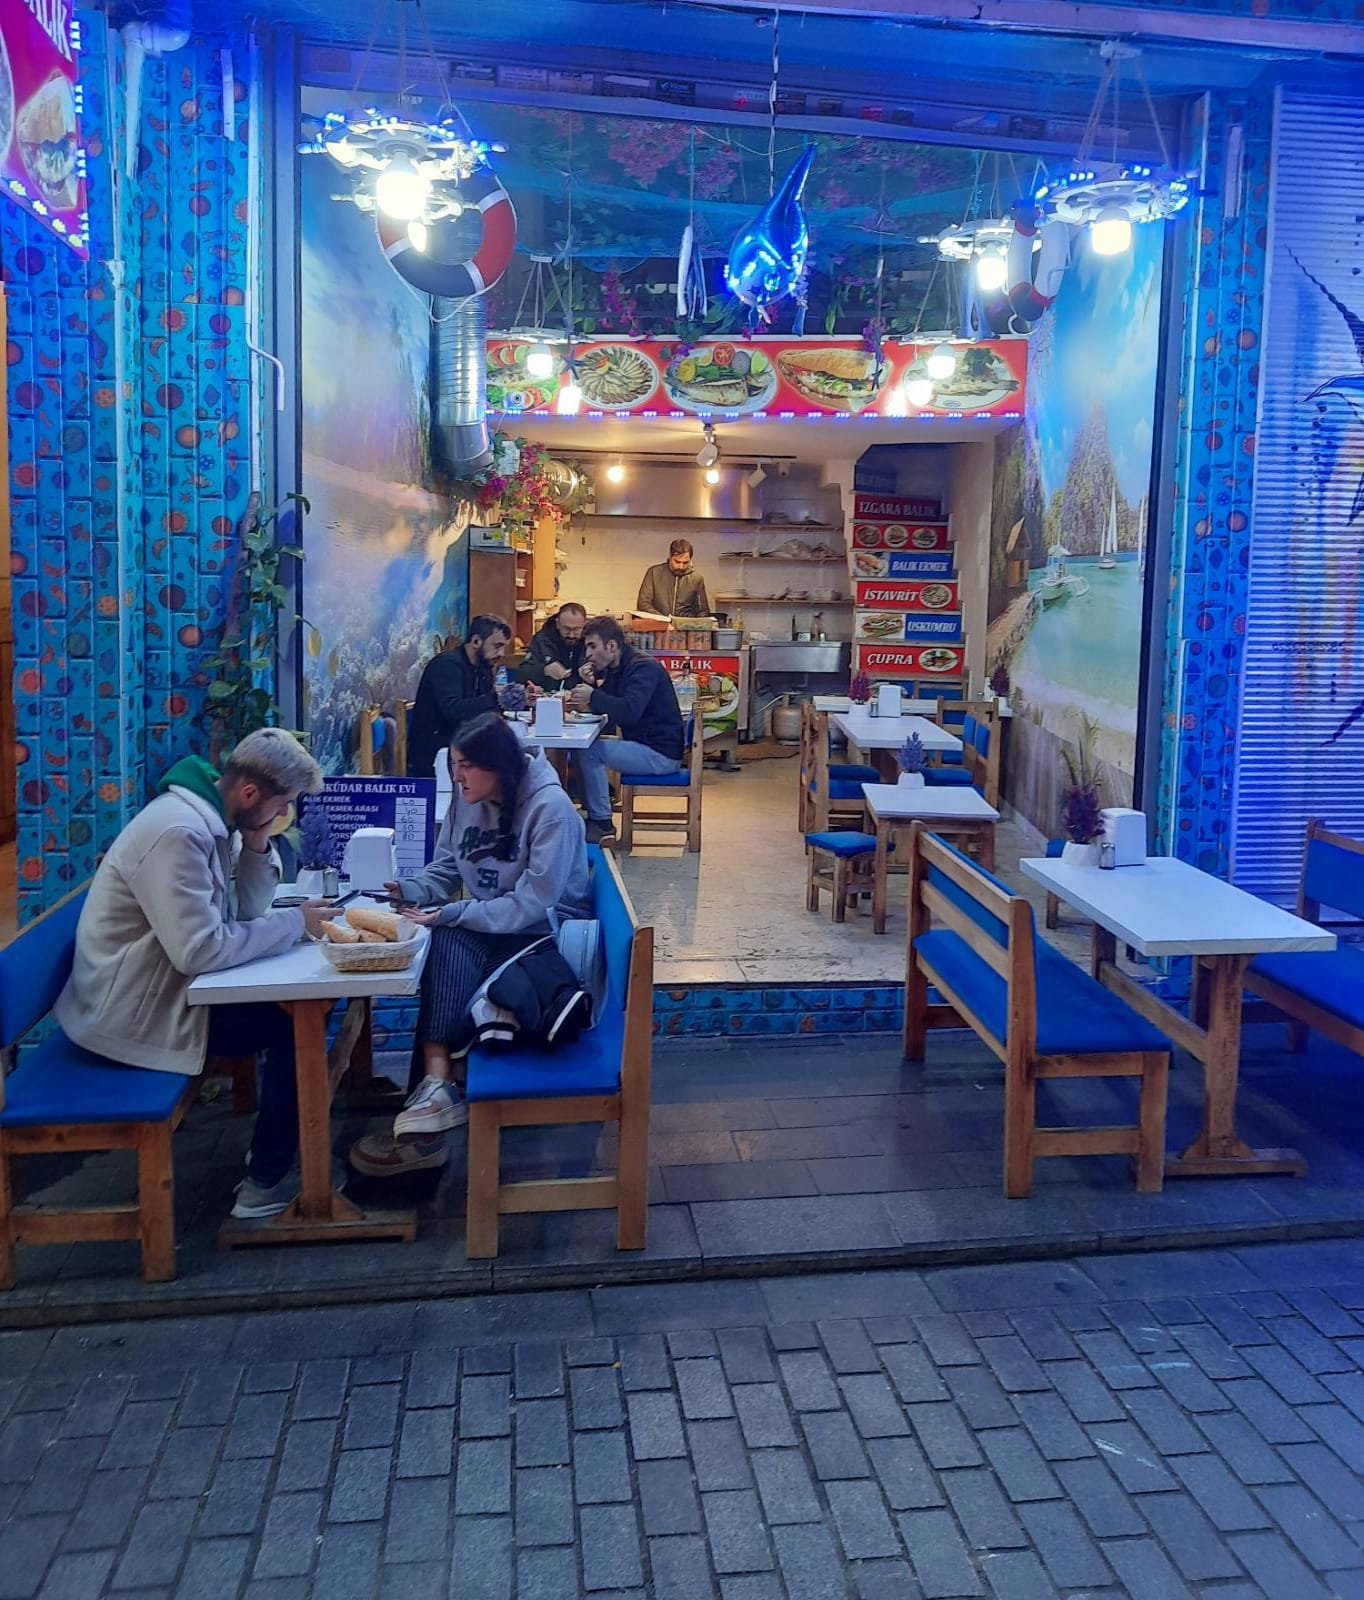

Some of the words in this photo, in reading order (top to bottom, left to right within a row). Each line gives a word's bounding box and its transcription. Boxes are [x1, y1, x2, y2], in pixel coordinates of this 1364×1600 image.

[859, 501, 899, 515] IZGARA
[902, 503, 935, 517] BALIK
[891, 561, 917, 571] BALIK
[919, 561, 948, 571] EKMEK
[864, 589, 919, 601] İSTAVRİT
[867, 653, 913, 666] ÇUPRA
[320, 782, 363, 793] KÜDAR
[365, 784, 397, 793] BALIK
[399, 783, 416, 793] EVİ
